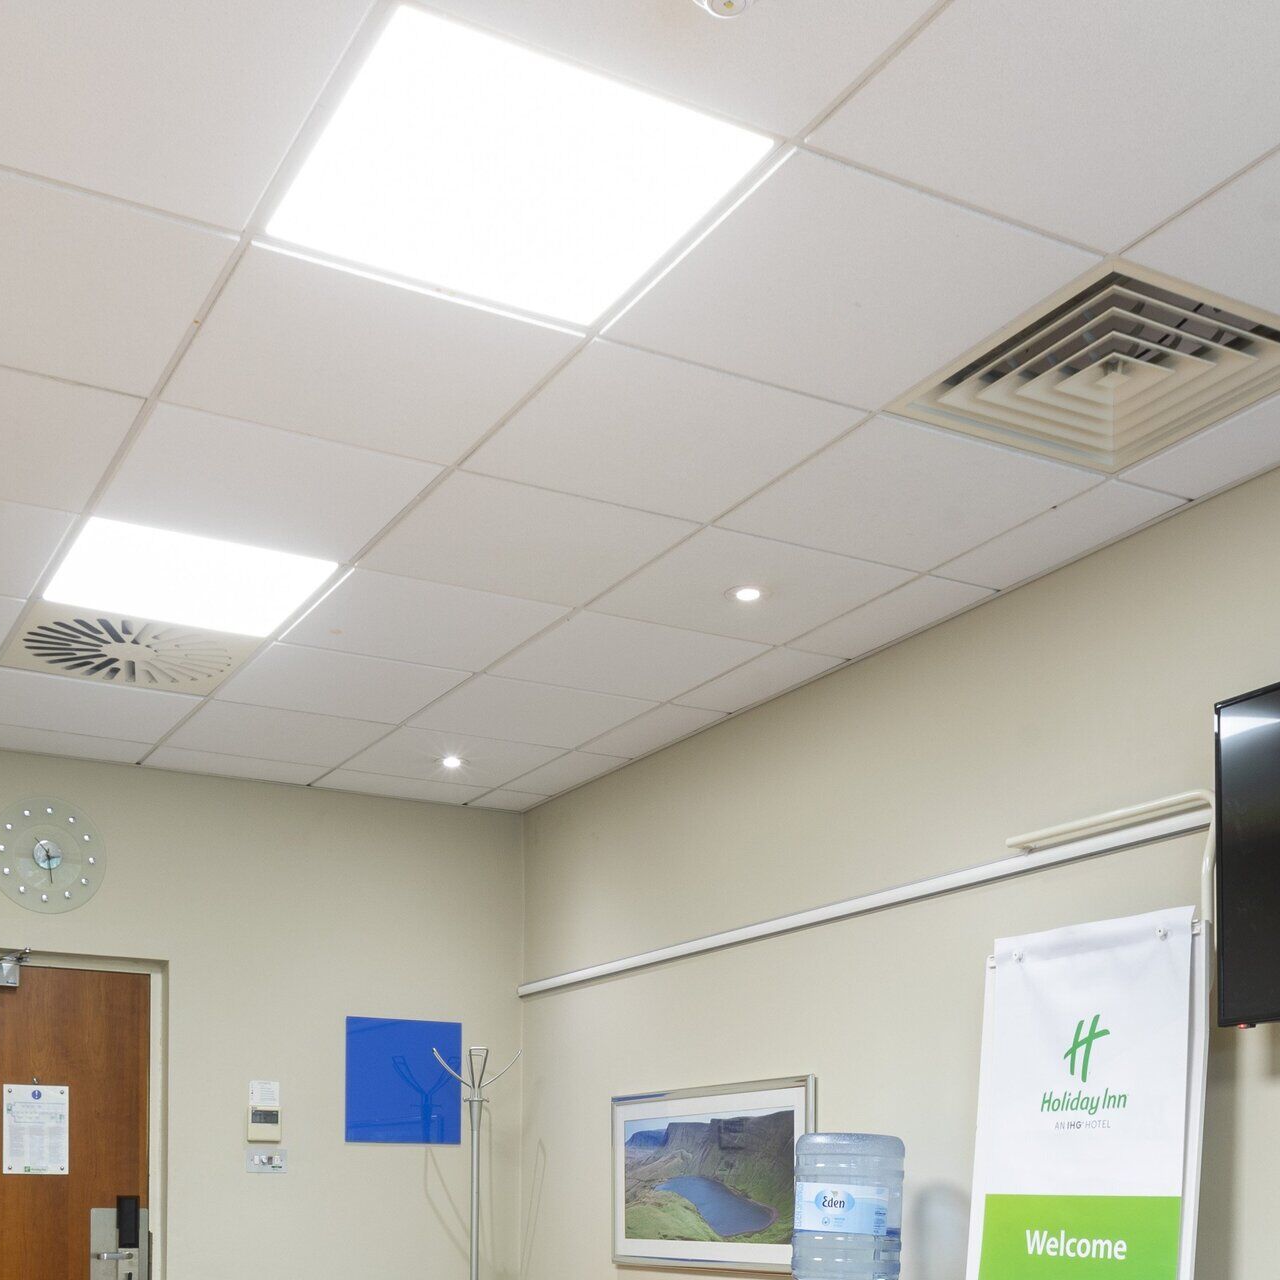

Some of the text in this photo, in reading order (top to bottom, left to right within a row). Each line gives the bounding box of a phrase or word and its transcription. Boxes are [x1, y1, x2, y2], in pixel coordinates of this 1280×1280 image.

[1040, 1087, 1128, 1115] Holiday Inn
[1054, 1121, 1065, 1130] AN
[1085, 1119, 1111, 1129] HOTEL
[822, 1195, 845, 1209] Eden
[1025, 1229, 1128, 1260] Welcome
